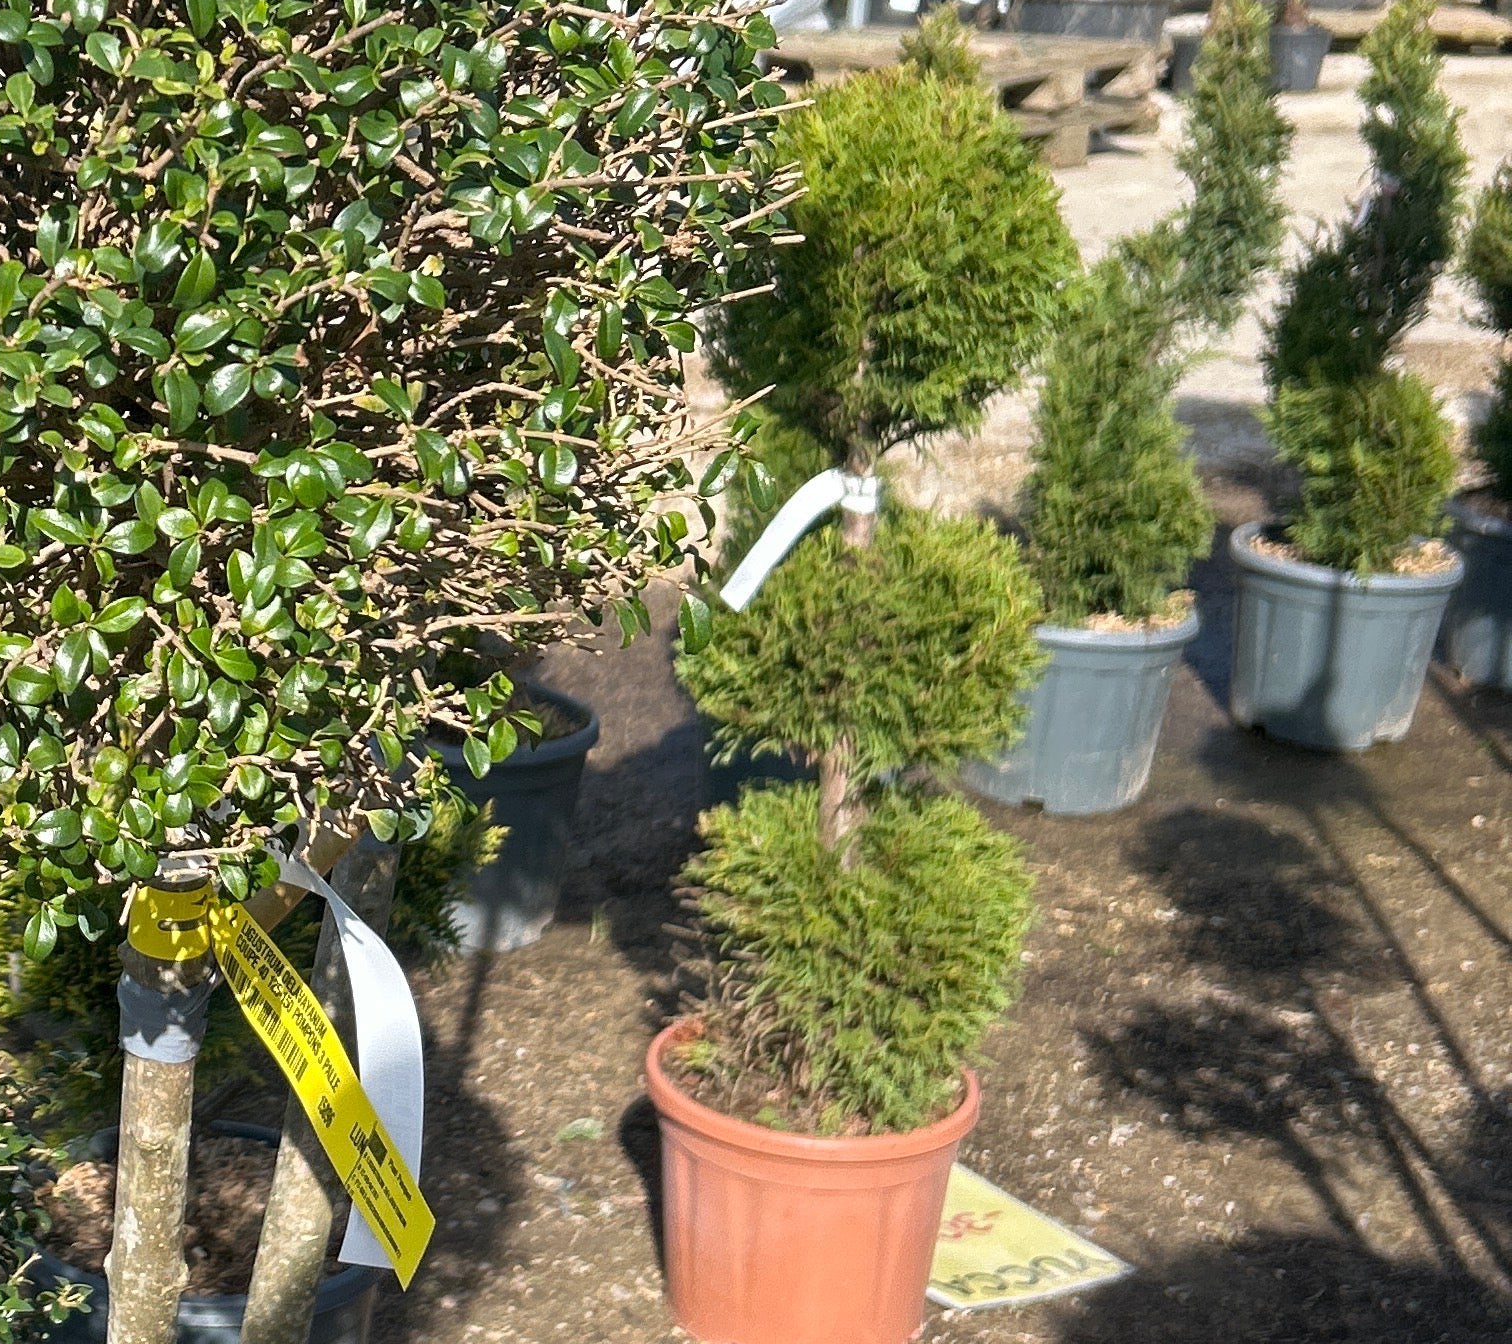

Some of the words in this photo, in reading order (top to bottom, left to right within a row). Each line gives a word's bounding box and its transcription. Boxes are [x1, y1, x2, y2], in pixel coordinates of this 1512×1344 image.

[236, 933, 260, 970] COUPE
[291, 1007, 322, 1056] POMPONS
[317, 1050, 326, 1064] 3
[241, 920, 285, 977] LIGUSTRUM
[282, 970, 327, 1040] DELAVAYANUM
